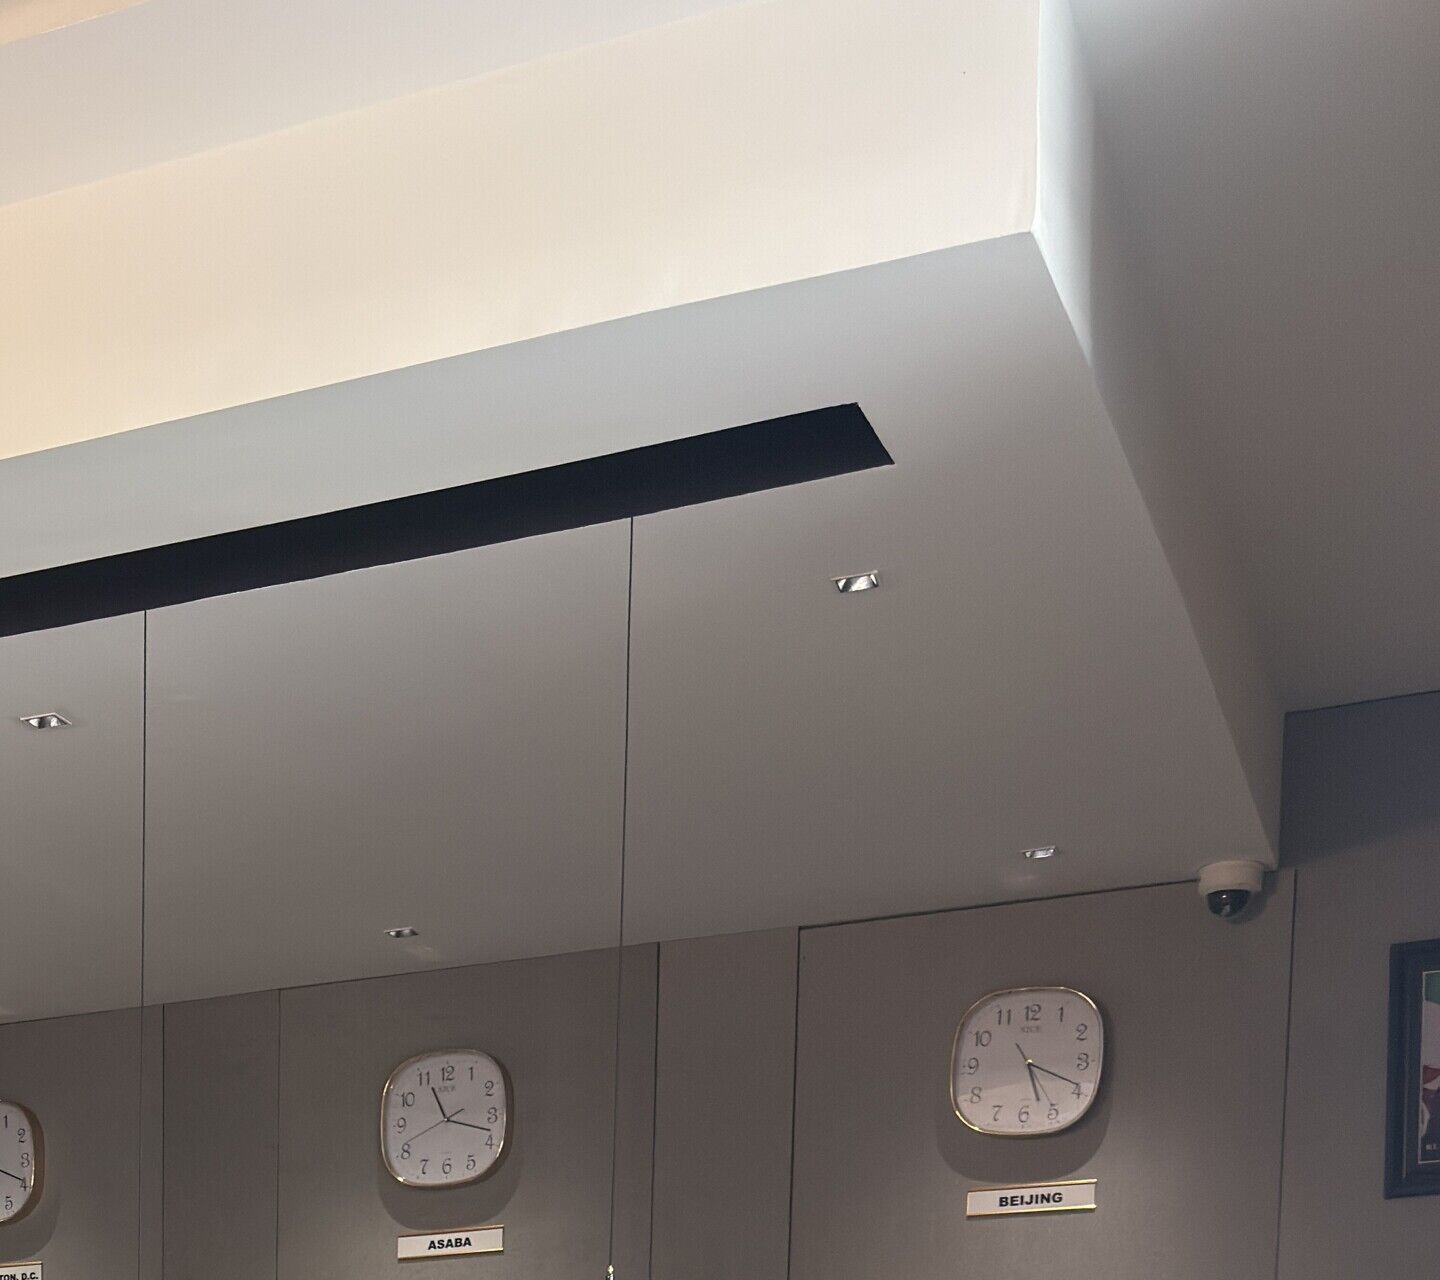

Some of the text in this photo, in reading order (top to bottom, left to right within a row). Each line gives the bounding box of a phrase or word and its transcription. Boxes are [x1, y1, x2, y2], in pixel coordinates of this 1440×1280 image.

[997, 1009, 1011, 1025] 11
[1024, 1004, 1041, 1021] 12
[1058, 1006, 1064, 1022] 1
[974, 1030, 992, 1047] 10
[1076, 1023, 1088, 1041] 2
[968, 1057, 979, 1076] 9
[1077, 1052, 1089, 1071] 3
[418, 1071, 430, 1086] 11
[441, 1065, 455, 1081] 12
[469, 1066, 474, 1080] 1
[484, 1080, 494, 1097] 2
[970, 1086, 982, 1104] 8
[1072, 1082, 1081, 1099] 4
[401, 1091, 415, 1107] 10
[487, 1106, 498, 1123] 3
[992, 1105, 1003, 1122] 7
[1018, 1105, 1029, 1123] 6
[1047, 1103, 1059, 1120] 5
[3, 1115, 8, 1128] 1
[397, 1117, 406, 1134] 9
[17, 1128, 26, 1143] 2
[484, 1134, 495, 1149] 4
[400, 1143, 411, 1159] 8
[21, 1152, 30, 1168] 3
[420, 1159, 428, 1175] 7
[441, 1158, 452, 1175] 6
[466, 1154, 476, 1171] 5
[19, 1177, 29, 1191] 4
[5, 1196, 13, 1210] 5
[999, 1192, 1063, 1207] BEIJING
[428, 1237, 472, 1250] ASABA
[21, 1272, 38, 1280] D.C.
